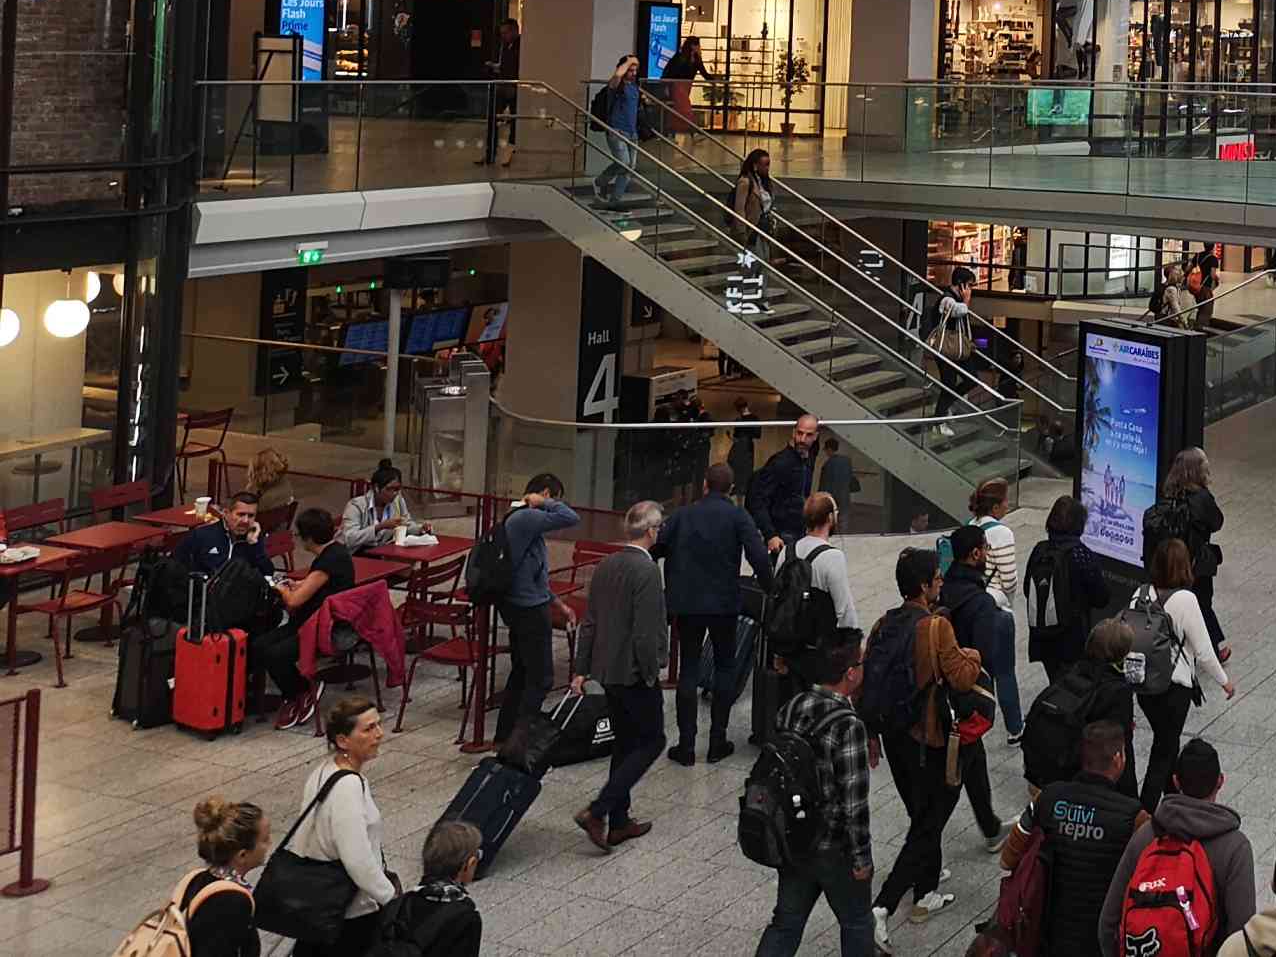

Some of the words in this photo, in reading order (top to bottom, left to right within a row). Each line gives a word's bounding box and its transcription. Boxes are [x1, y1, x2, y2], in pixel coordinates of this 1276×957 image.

[282, 8, 306, 20] Flash
[587, 329, 611, 346] Hall
[583, 352, 619, 424] 4
[1054, 800, 1096, 824] Suivi
[1058, 821, 1104, 841] repro
